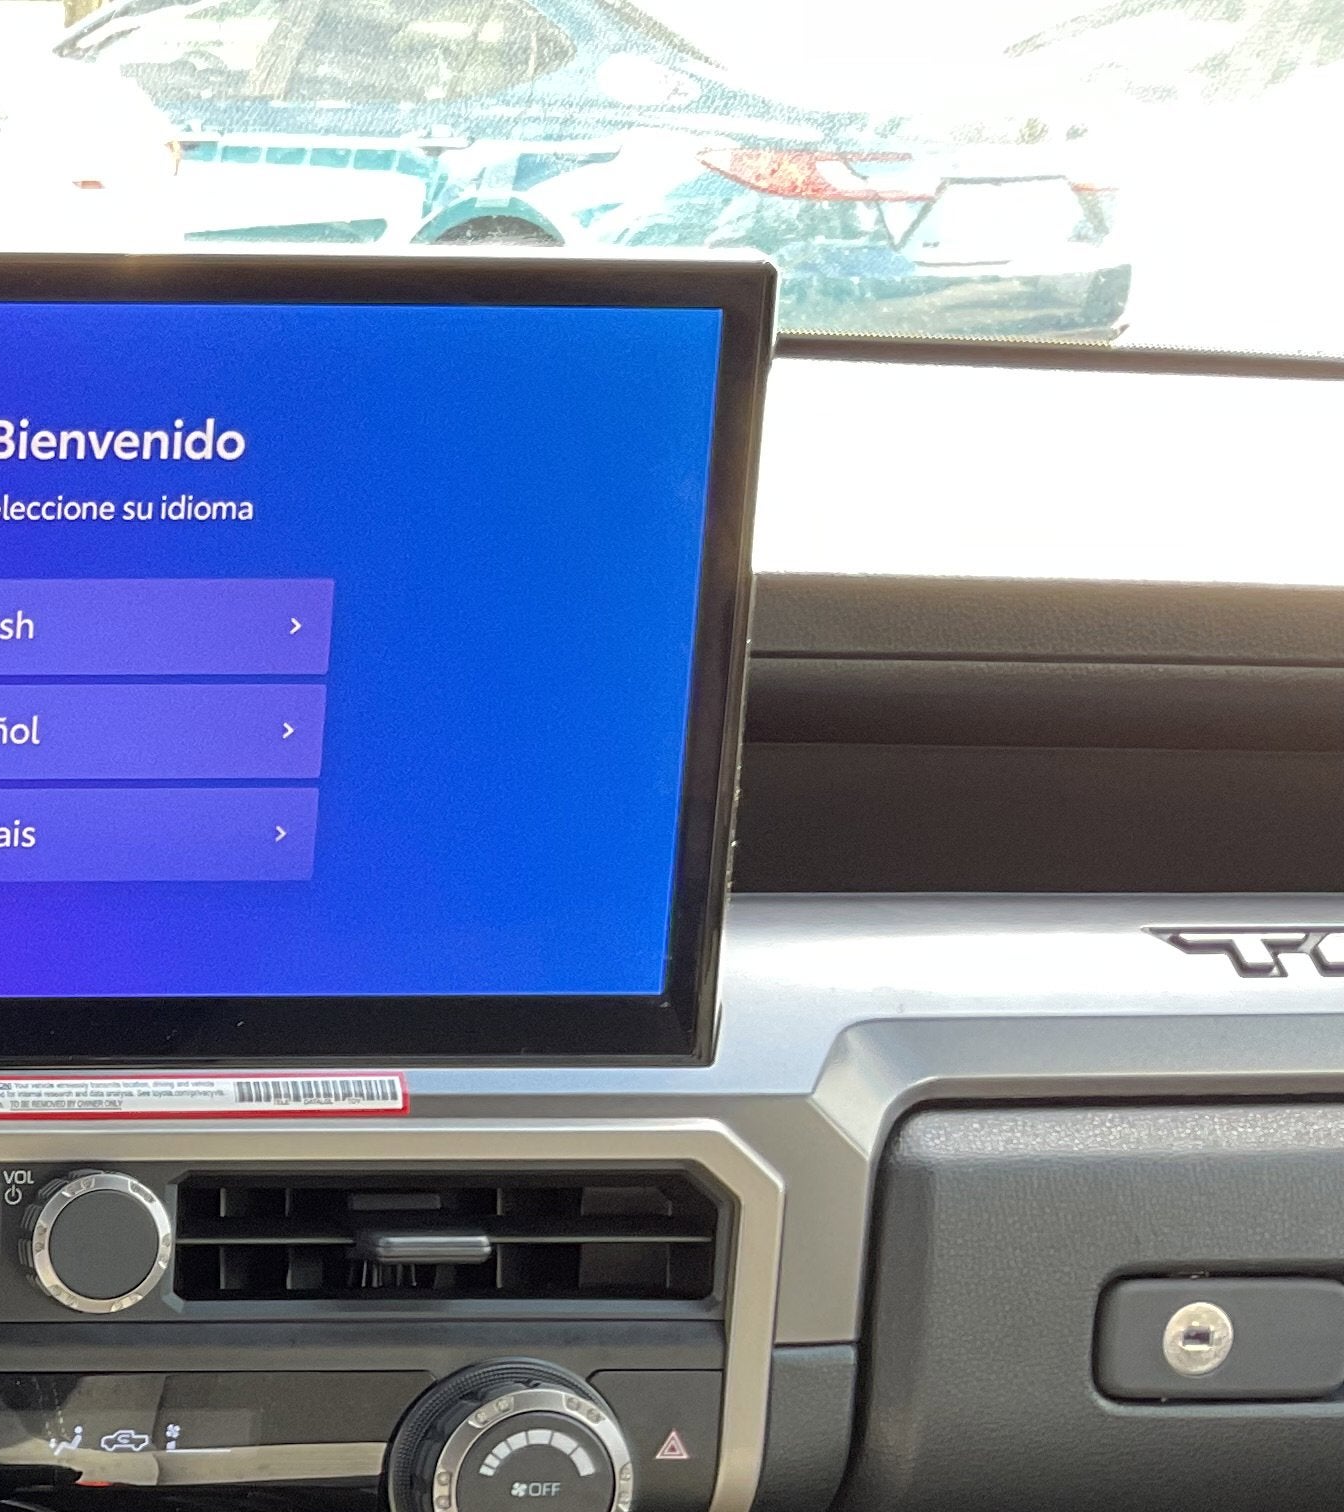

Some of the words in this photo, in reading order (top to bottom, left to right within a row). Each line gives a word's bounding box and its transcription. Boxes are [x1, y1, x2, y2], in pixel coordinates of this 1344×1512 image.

[123, 500, 154, 521] su
[160, 495, 254, 521] idioma
[3, 1171, 34, 1184] VOL
[528, 1483, 561, 1497] OFF
